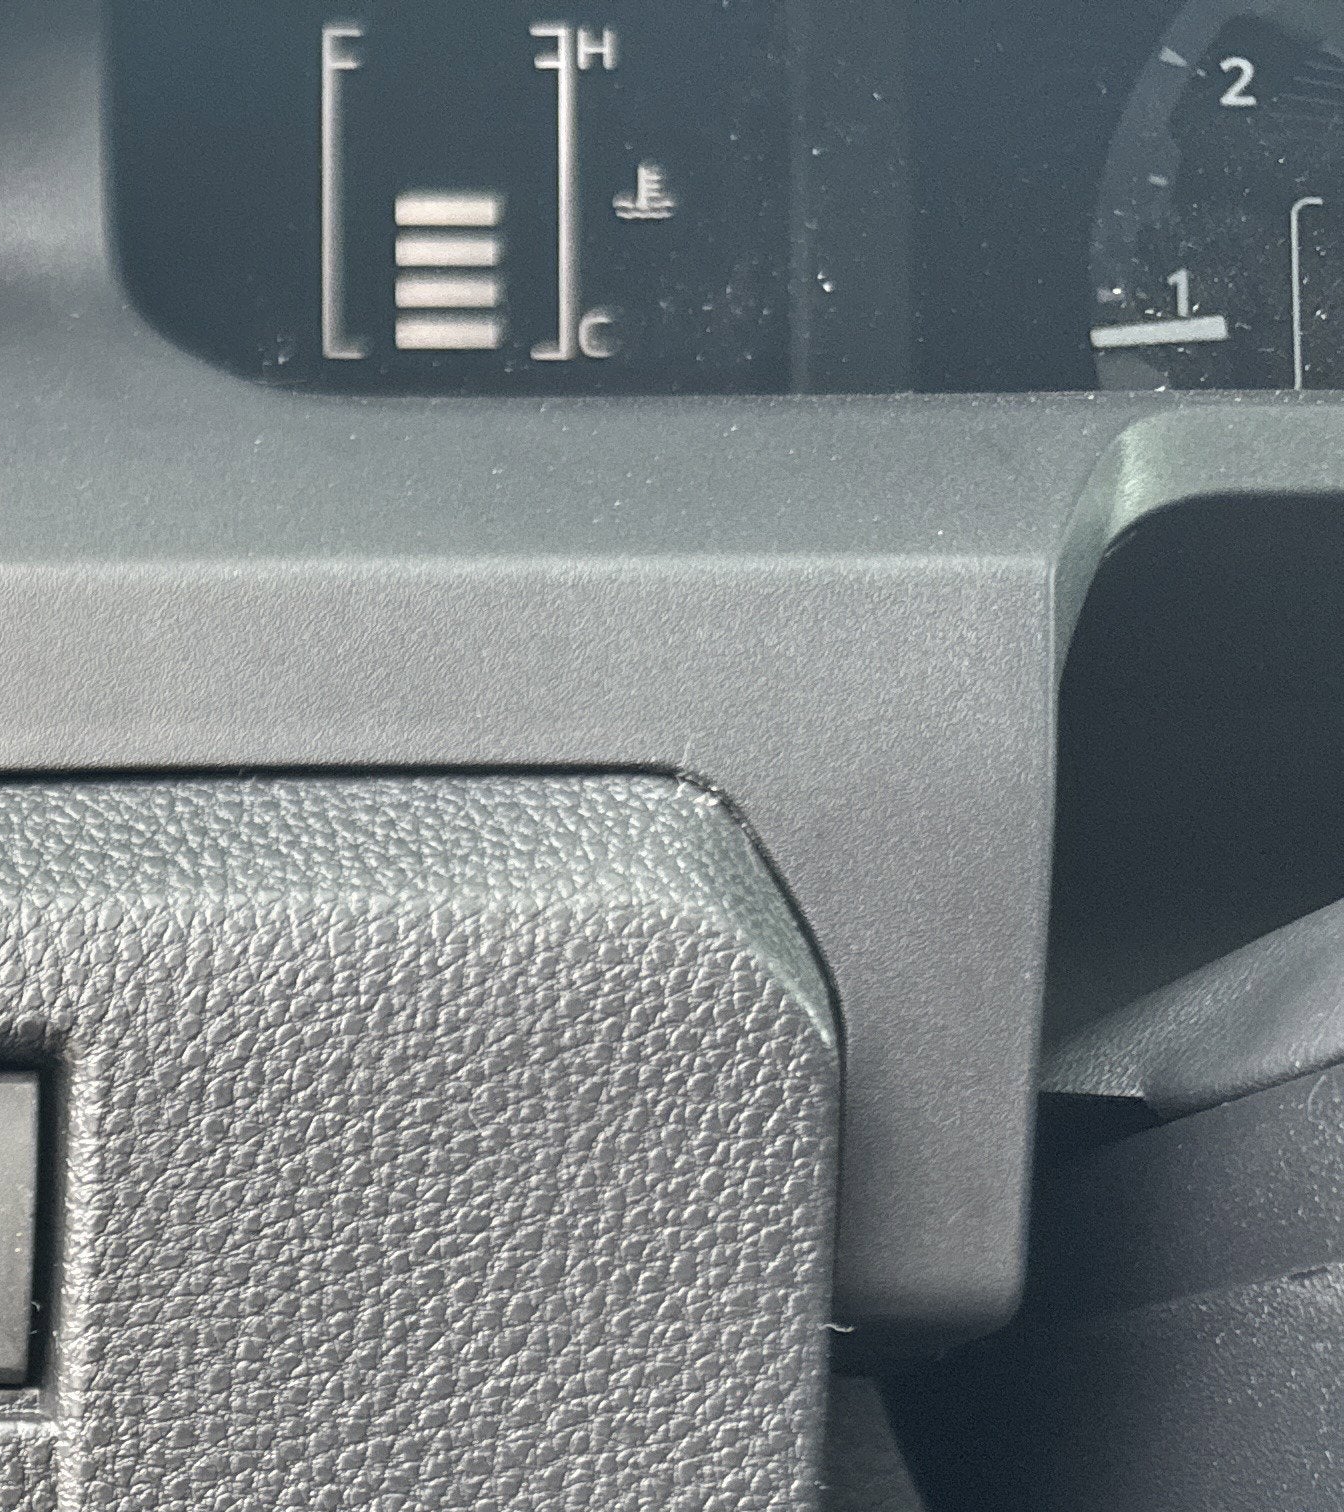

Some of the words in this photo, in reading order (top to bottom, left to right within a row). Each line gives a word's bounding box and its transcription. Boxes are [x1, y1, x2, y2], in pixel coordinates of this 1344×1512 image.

[577, 27, 616, 70] H
[1220, 57, 1257, 107] 2
[1167, 268, 1189, 317] 1
